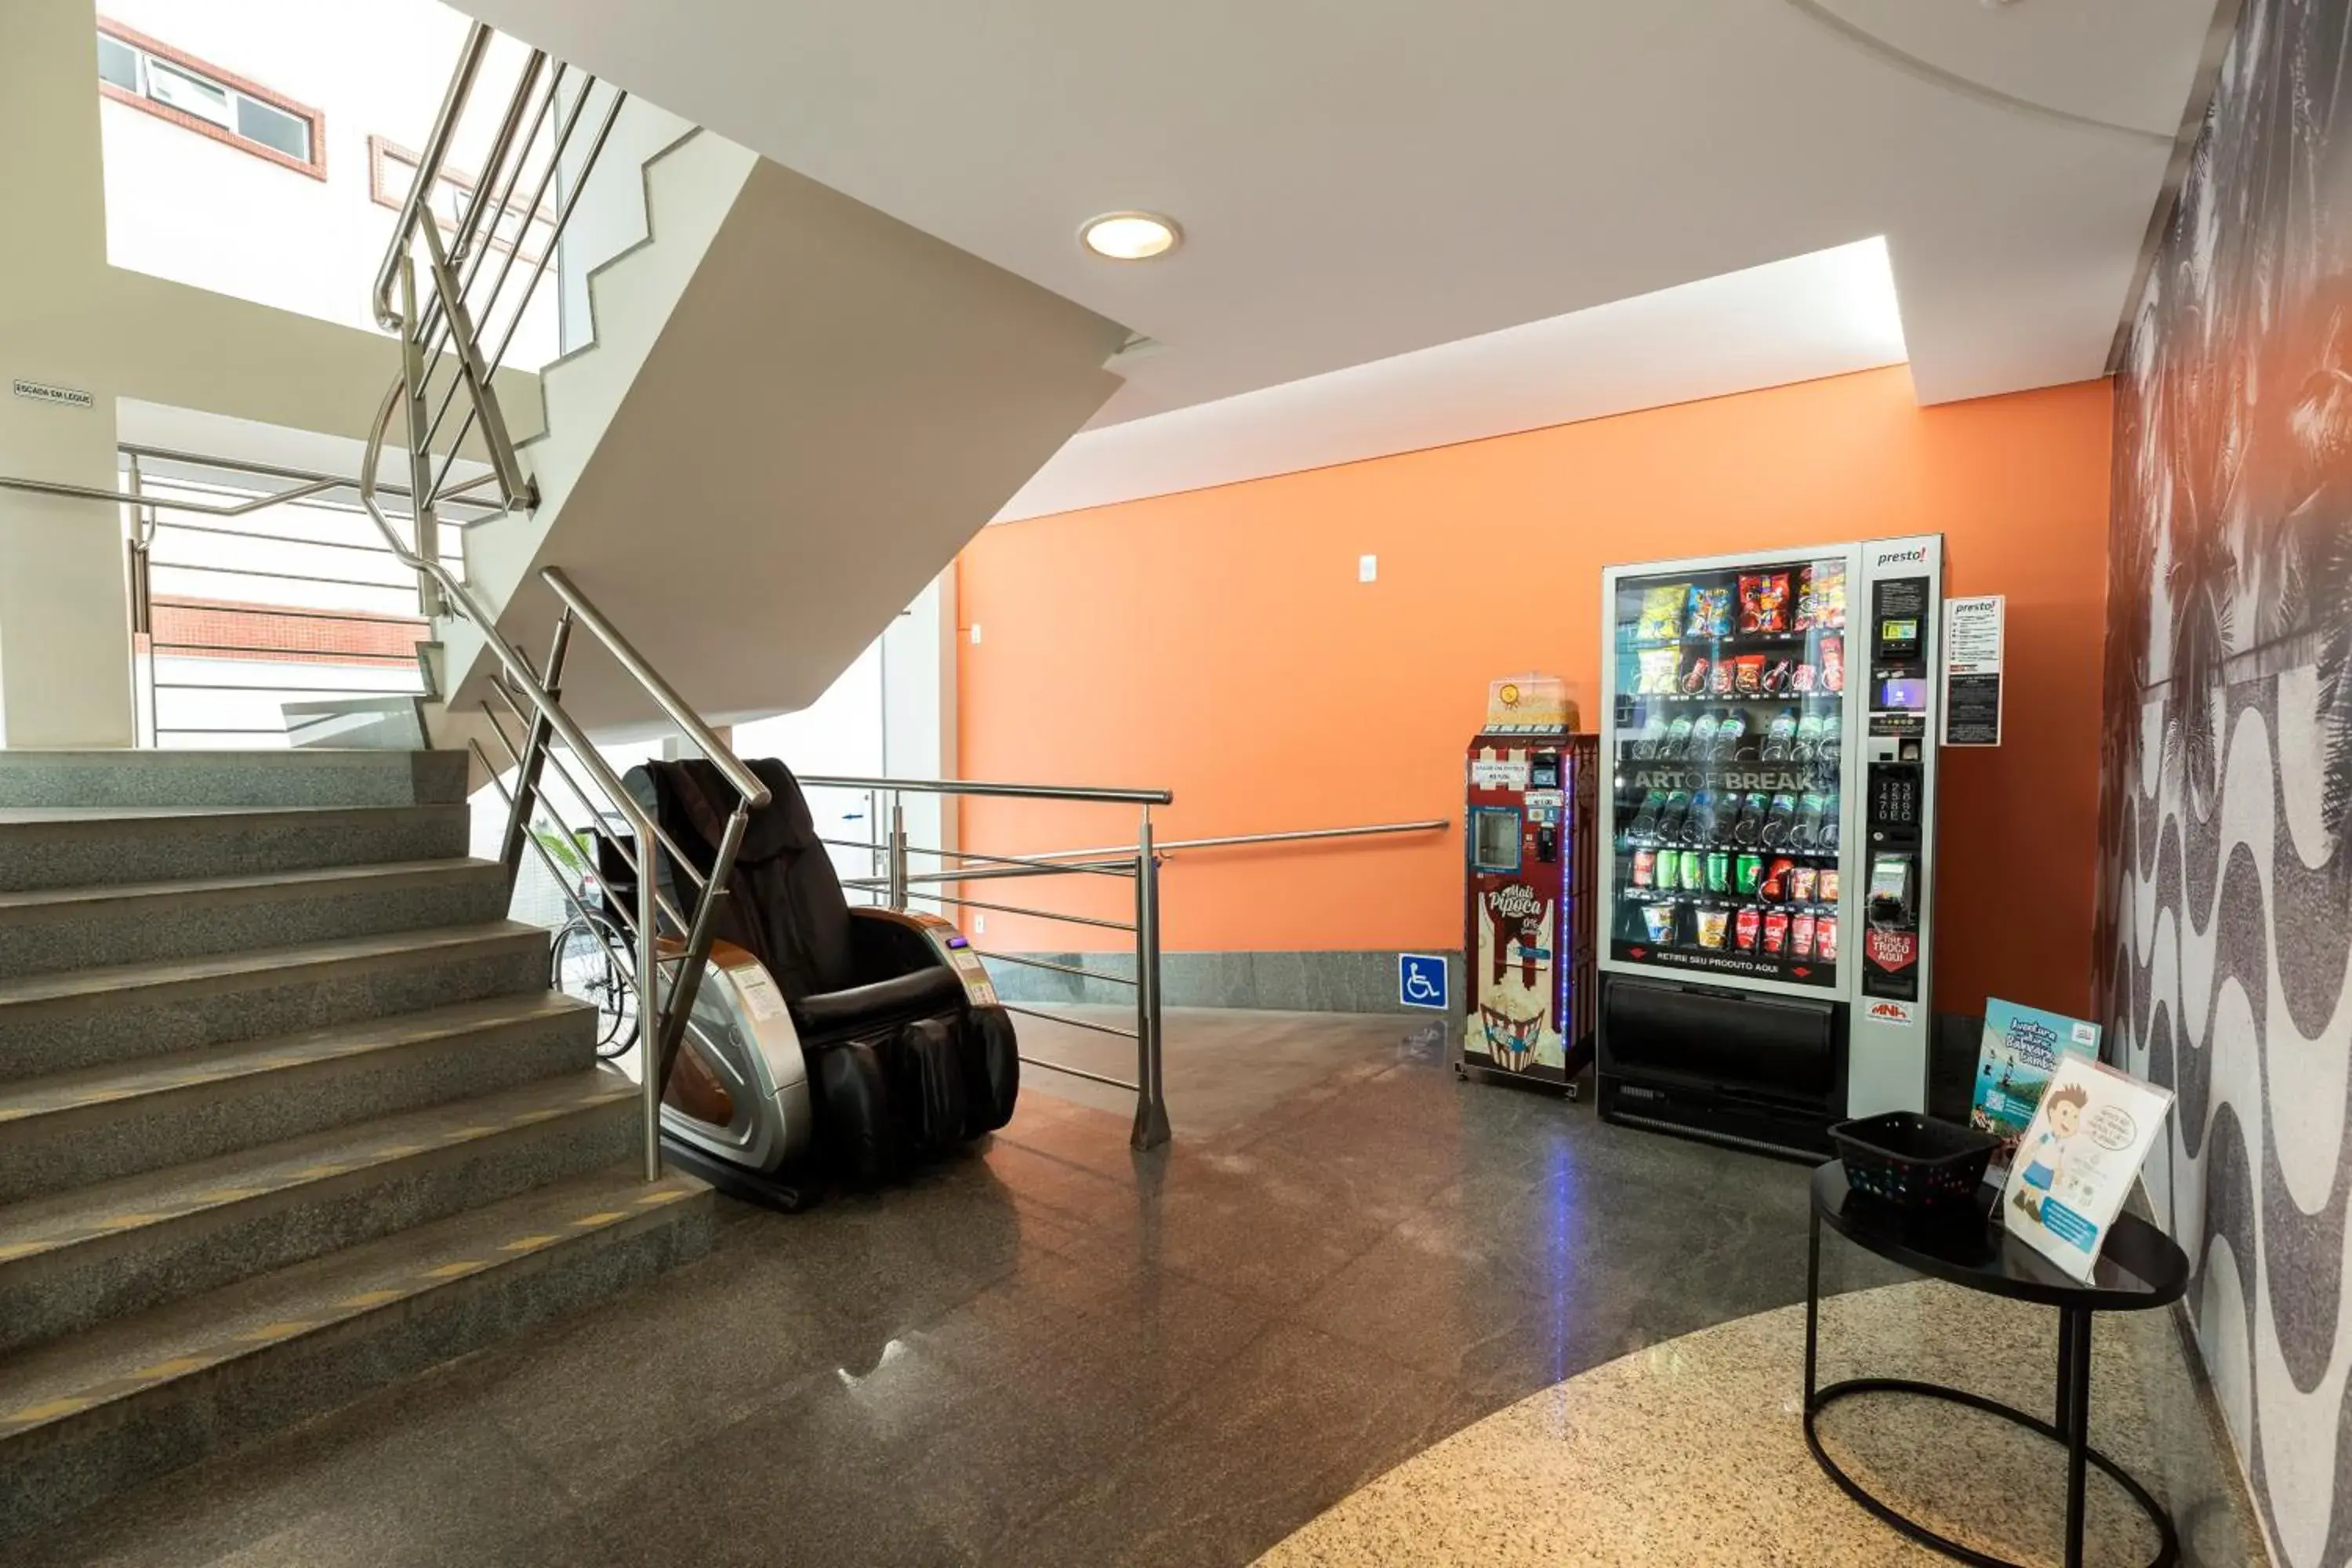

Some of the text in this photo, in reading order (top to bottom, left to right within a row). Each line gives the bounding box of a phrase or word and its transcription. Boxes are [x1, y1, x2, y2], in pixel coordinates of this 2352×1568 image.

[16, 383, 49, 396] ESCADA
[64, 392, 90, 404] LEQUE
[1878, 546, 1926, 566] presto!
[1955, 601, 1996, 615] presto!
[1726, 771, 1813, 790] BREAK
[1891, 782, 1900, 792] 2
[1903, 782, 1911, 792] 3
[1878, 792, 1887, 800] 4
[1878, 801, 1887, 811] 7
[1489, 891, 1541, 917] Pipoca
[1873, 942, 1909, 954] TROCO
[1657, 952, 1779, 973] RETIRE SEU PRODUTO AQUI
[1877, 951, 1903, 962] AQUI
[2010, 1018, 2057, 1041] Aventura
